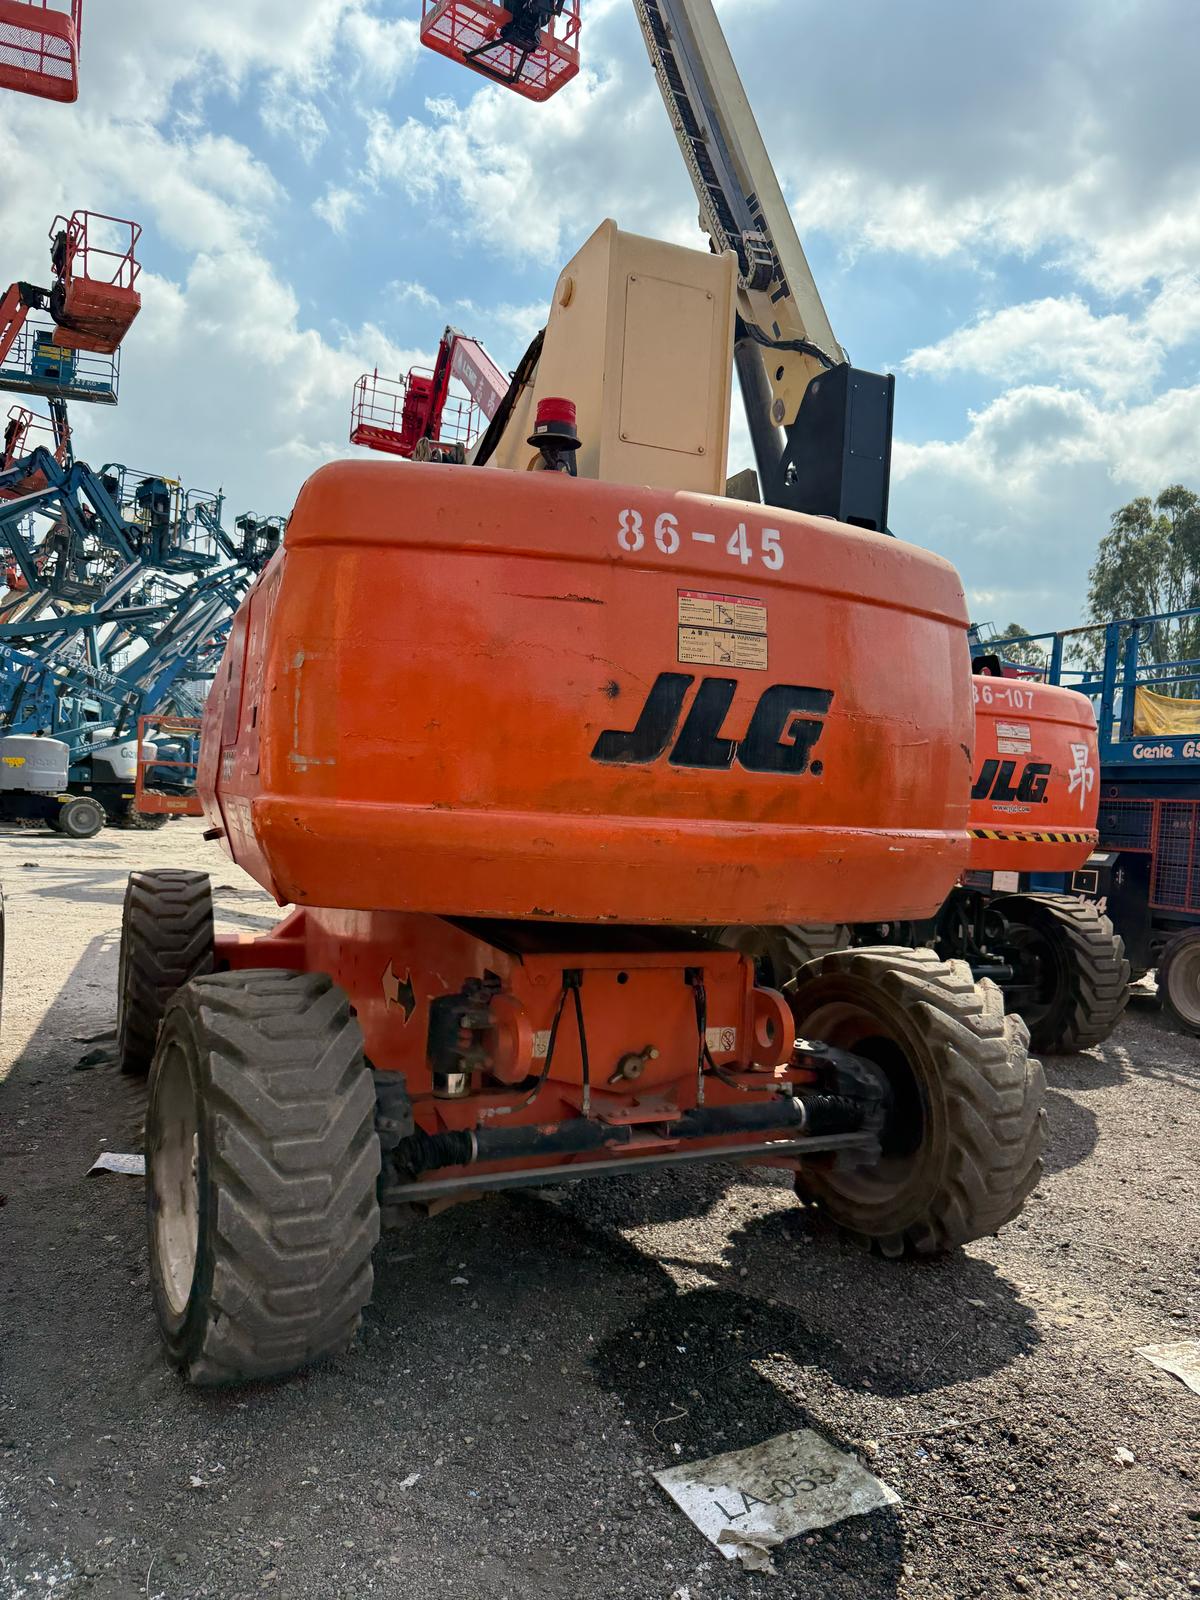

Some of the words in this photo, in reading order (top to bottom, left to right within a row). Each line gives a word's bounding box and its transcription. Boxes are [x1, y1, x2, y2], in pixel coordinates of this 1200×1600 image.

[617, 508, 785, 571] 86-45
[591, 672, 835, 776] JLG
[1132, 743, 1173, 759] Genie
[971, 758, 1052, 804] JLG
[1067, 743, 1095, 812] 昂
[712, 1467, 837, 1522] LA-053
